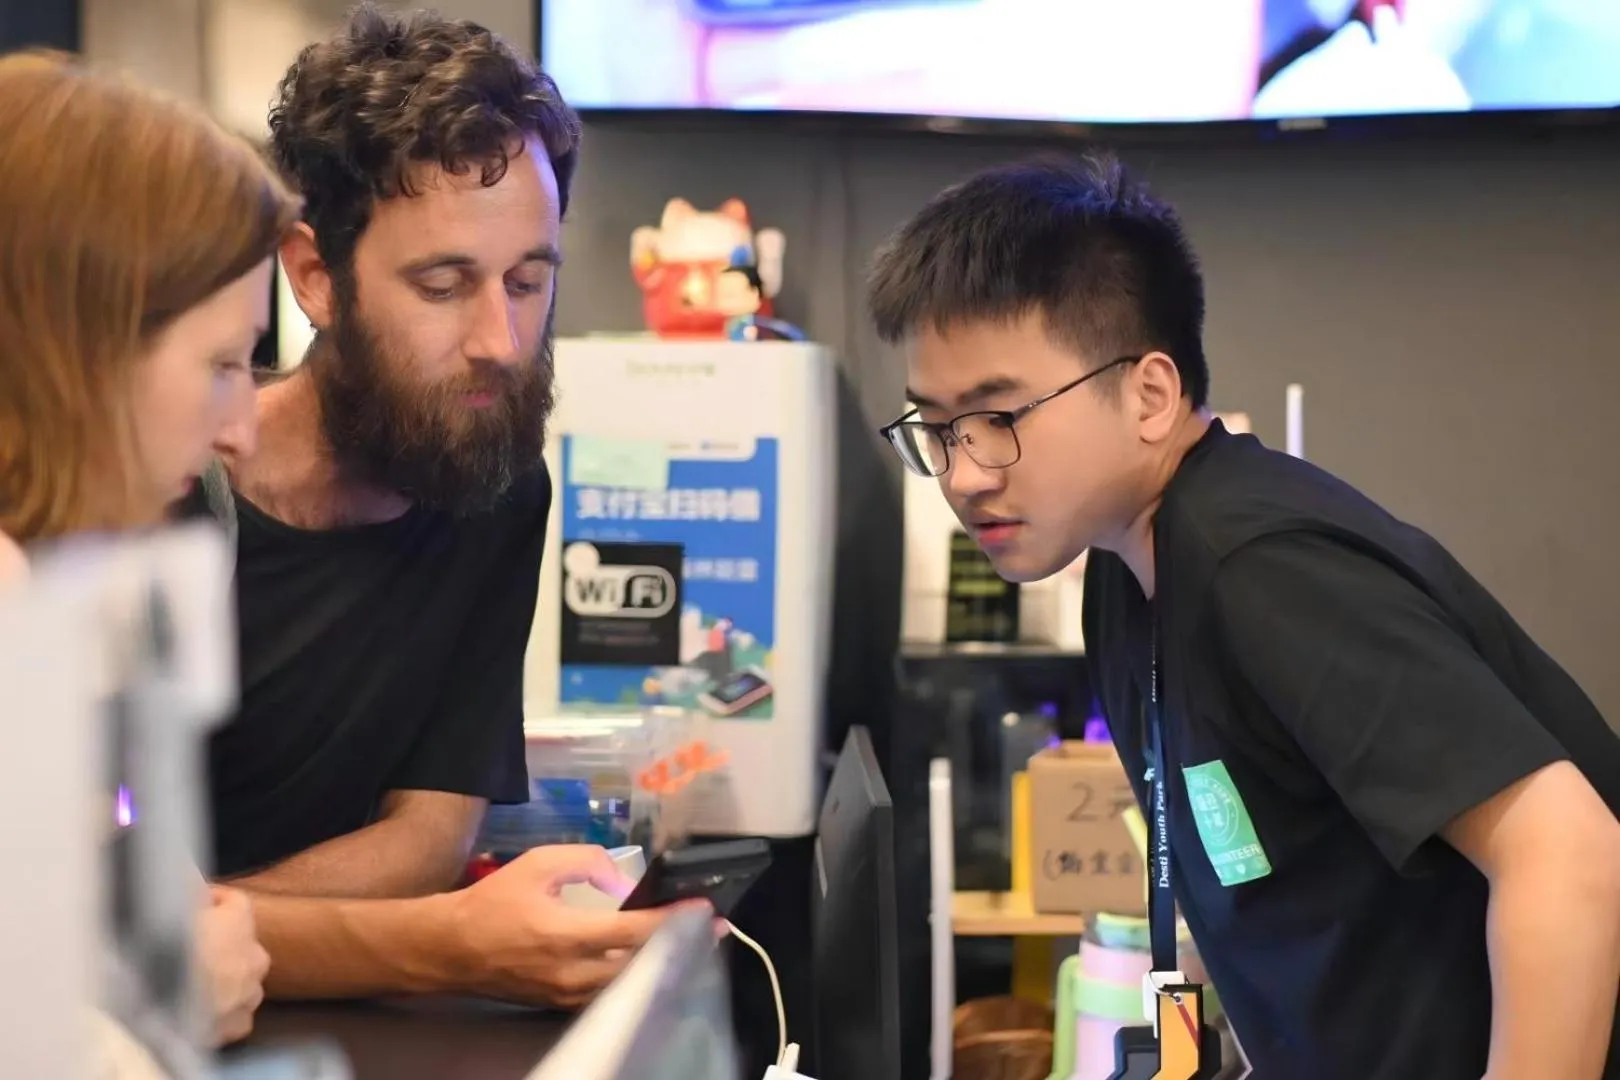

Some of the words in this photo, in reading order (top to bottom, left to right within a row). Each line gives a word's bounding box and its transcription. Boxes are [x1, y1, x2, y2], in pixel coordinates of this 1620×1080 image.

[1156, 781, 1165, 811] Park
[1158, 814, 1168, 853] Youth
[1158, 856, 1170, 888] Desti
